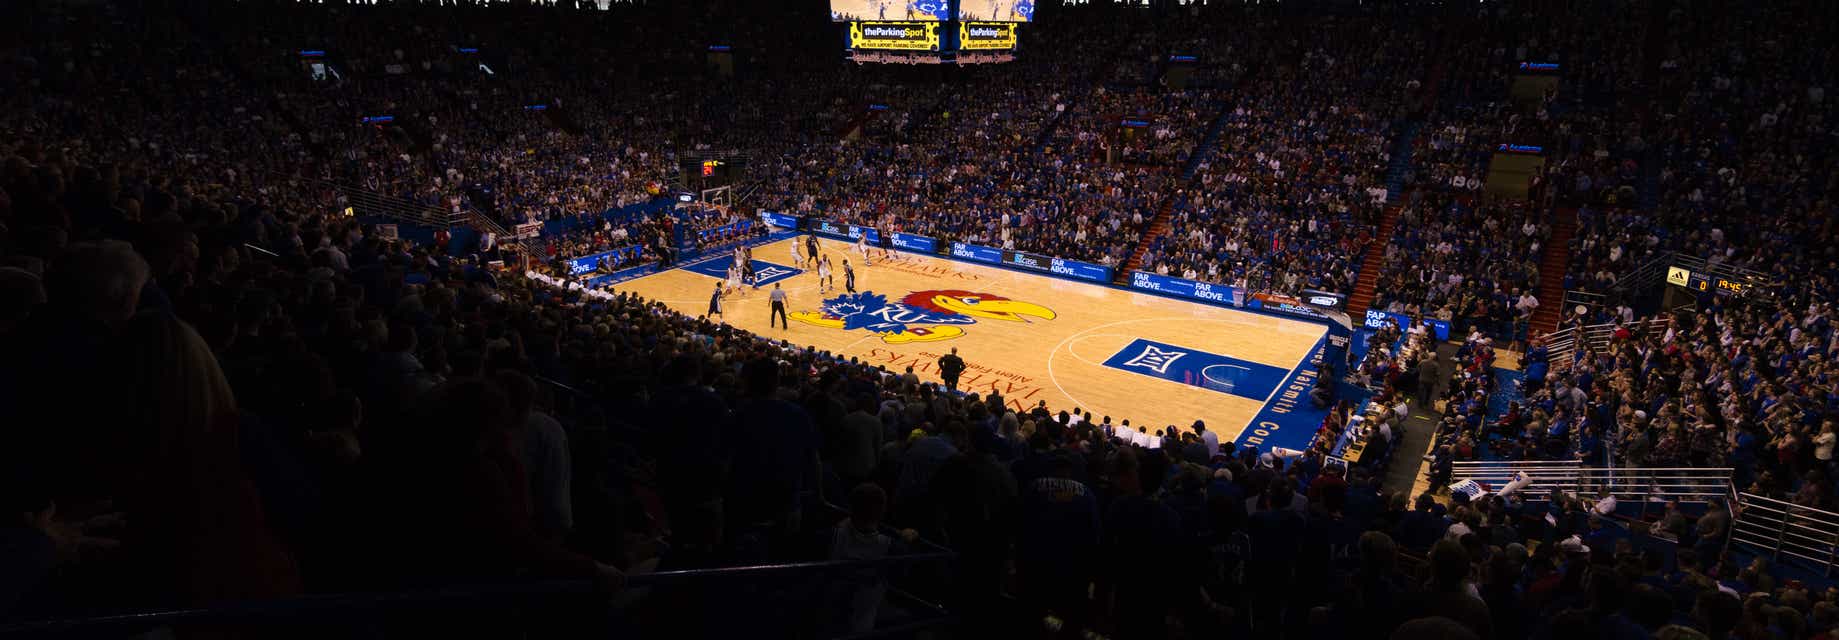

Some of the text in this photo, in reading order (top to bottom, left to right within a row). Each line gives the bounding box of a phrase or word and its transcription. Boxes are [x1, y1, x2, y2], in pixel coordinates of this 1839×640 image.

[864, 27, 923, 38] theParkingSpot
[954, 242, 966, 250] FAR
[953, 249, 975, 259] ABOVE
[1051, 258, 1065, 267] FAR
[1050, 265, 1074, 276] ABOVE
[1134, 272, 1150, 283] FAR
[1133, 279, 1161, 291] ABOVE
[1195, 282, 1212, 293] FAR
[1699, 280, 1707, 291] 0
[1194, 290, 1224, 302] ABOVE
[1271, 369, 1318, 414] Naismith
